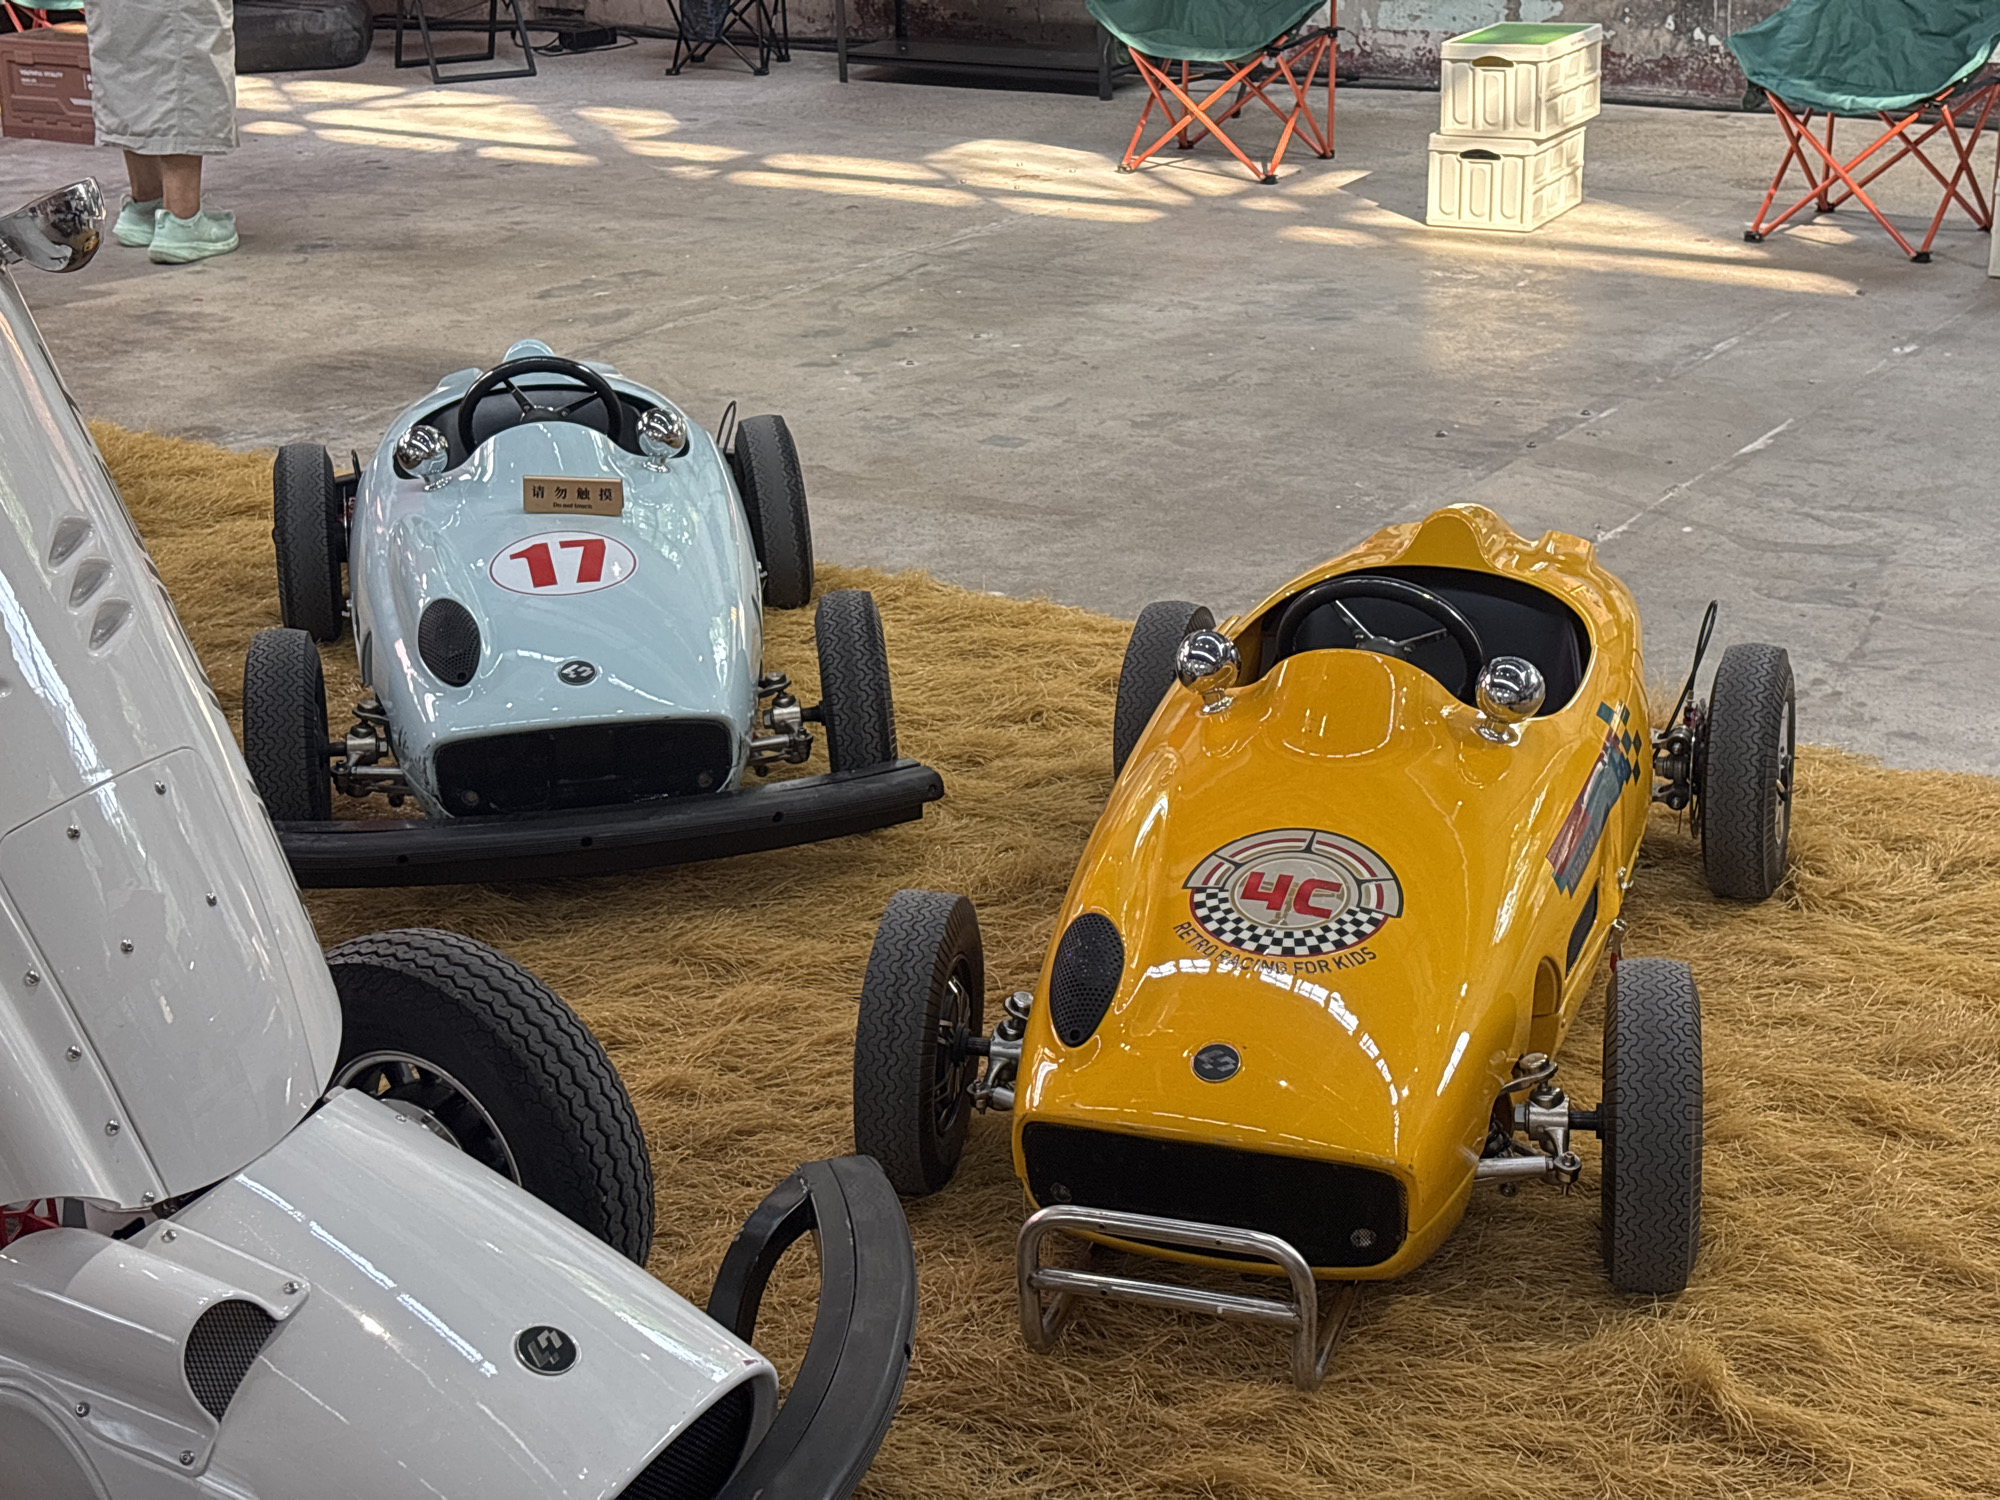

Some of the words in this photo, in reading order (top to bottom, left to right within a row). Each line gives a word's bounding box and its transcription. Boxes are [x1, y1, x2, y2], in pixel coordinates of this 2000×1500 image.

[532, 485, 613, 502] 请勿触摸
[509, 538, 606, 588] 17
[1240, 871, 1343, 919] 4C
[1173, 921, 1219, 957] RETRO
[1215, 949, 1288, 975] RACING
[1293, 960, 1331, 975] FOR
[1333, 946, 1377, 970] KIDS
